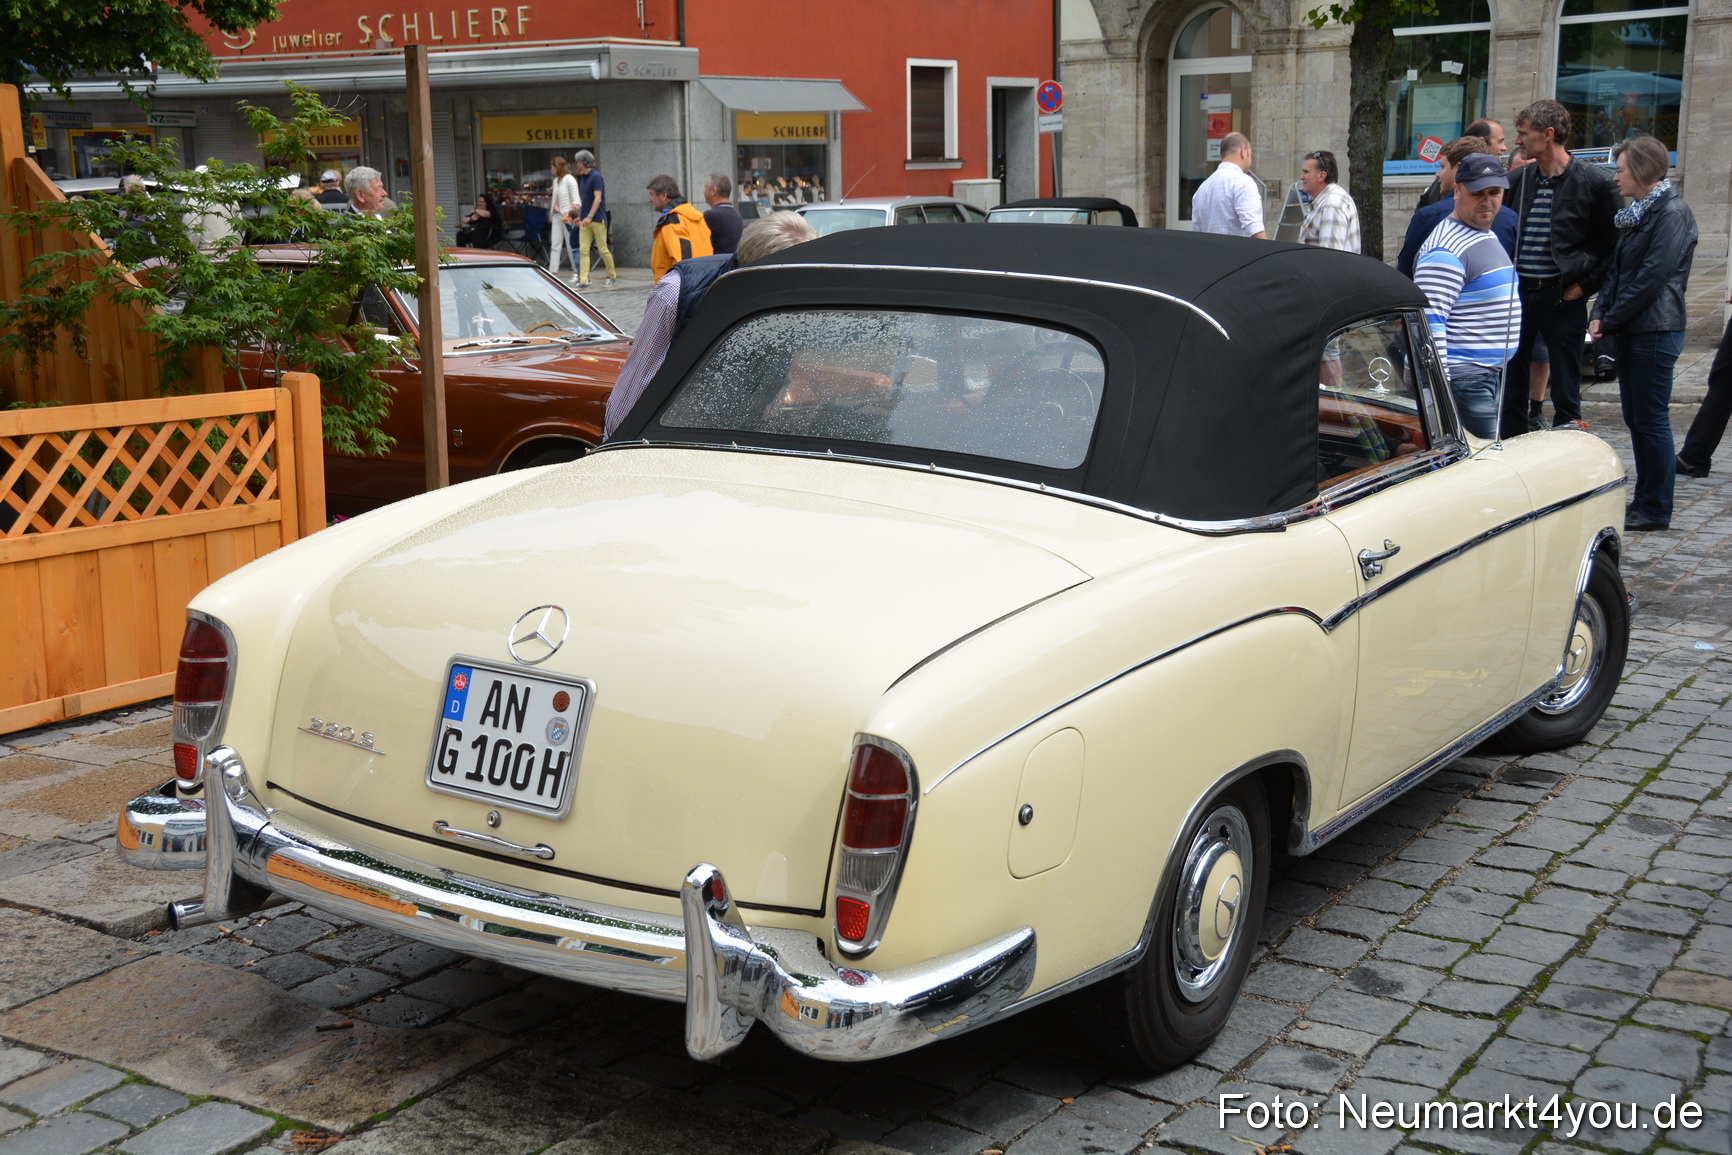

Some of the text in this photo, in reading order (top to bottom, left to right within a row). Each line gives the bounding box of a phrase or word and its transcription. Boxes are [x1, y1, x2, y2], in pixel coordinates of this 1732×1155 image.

[271, 29, 343, 51] juwelier
[357, 5, 533, 44] SCHLIERF
[633, 66, 678, 77] SCHLIERF
[150, 115, 166, 123] NZ
[526, 127, 594, 141] SCHLIERF
[773, 127, 825, 137] SCHLIERF
[451, 700, 460, 713] D
[479, 680, 531, 733] AN
[437, 729, 463, 776] G
[465, 735, 536, 791] 100
